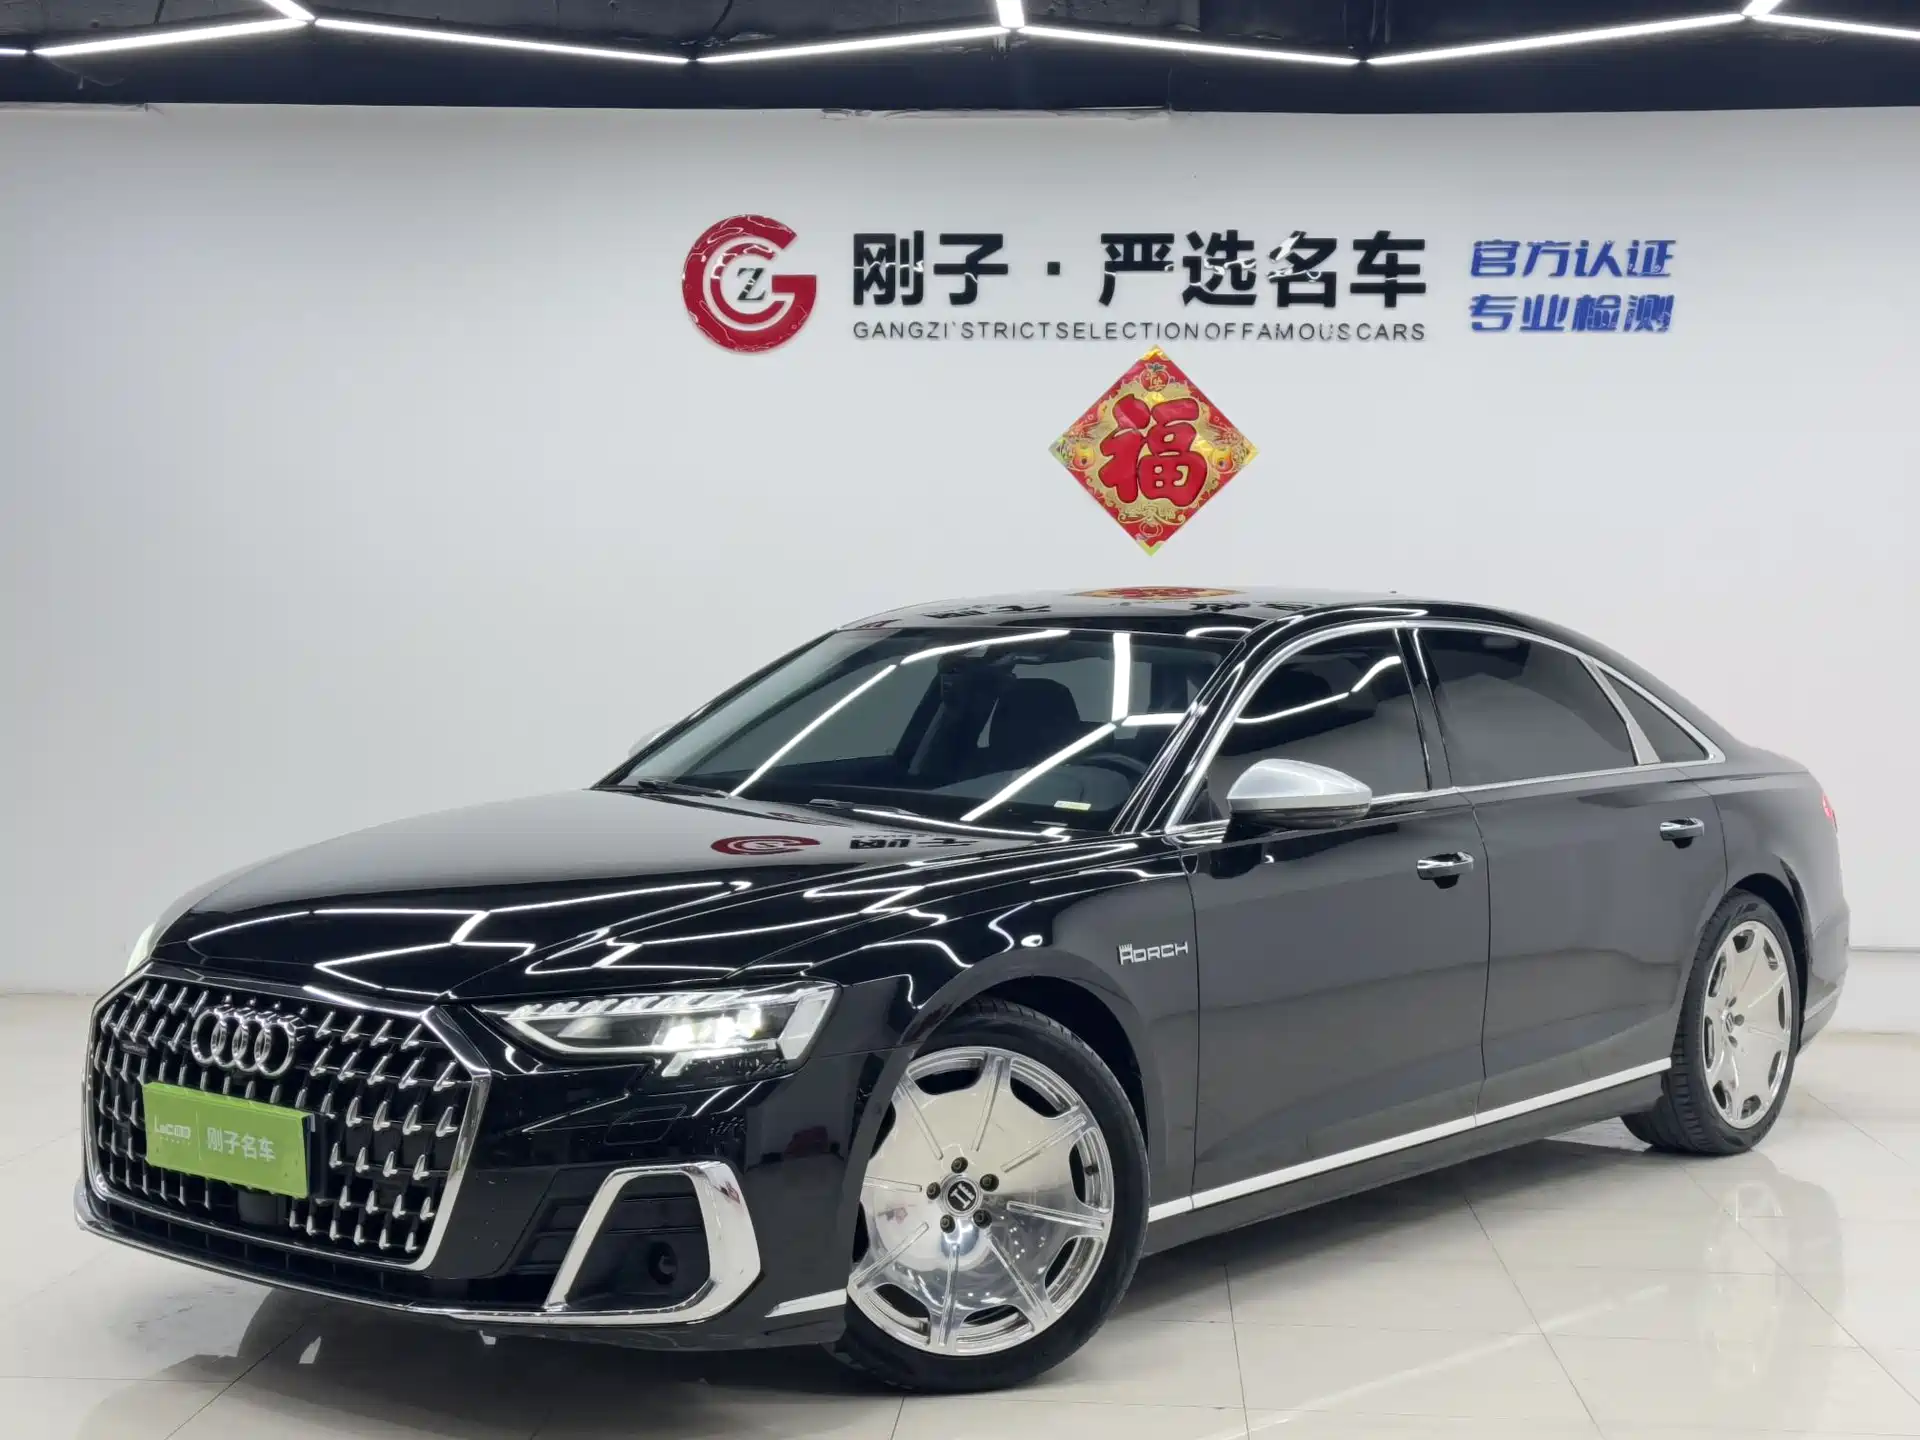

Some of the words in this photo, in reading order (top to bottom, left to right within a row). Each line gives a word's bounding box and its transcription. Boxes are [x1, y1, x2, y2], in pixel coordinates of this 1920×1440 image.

[1470, 239, 1676, 279] 官方认证
[1470, 294, 1675, 333] 专业检测
[1098, 393, 1208, 507] 福
[206, 1126, 277, 1162] 刚子名车
